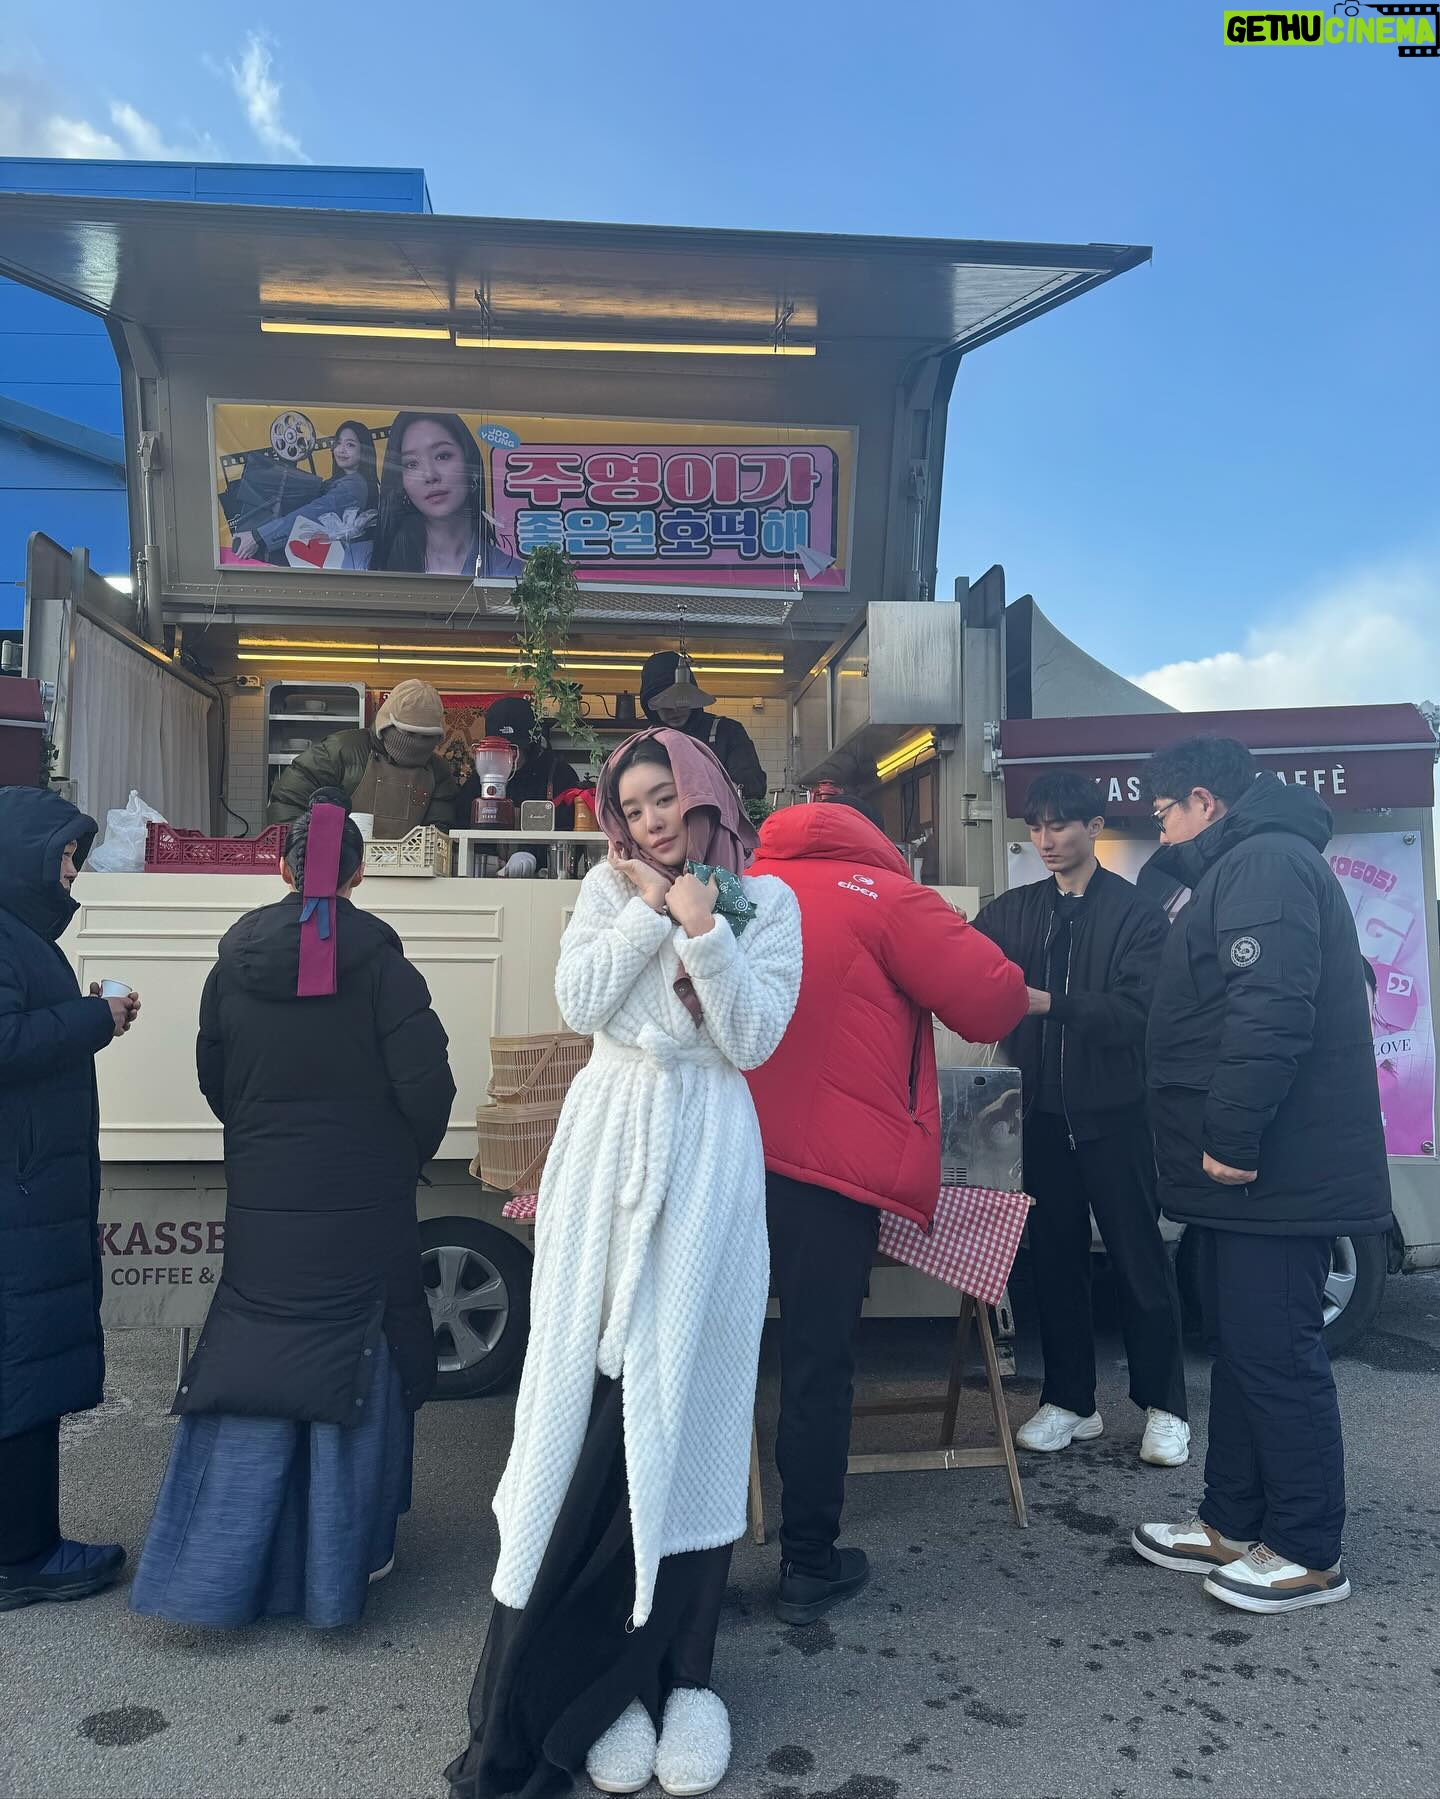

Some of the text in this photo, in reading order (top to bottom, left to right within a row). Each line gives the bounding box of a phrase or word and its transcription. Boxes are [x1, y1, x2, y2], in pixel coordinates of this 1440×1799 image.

[481, 431, 515, 448] YOUNG
[489, 428, 510, 439] JOO
[504, 452, 822, 506] 주영이가
[1095, 776, 1140, 802] AS
[1255, 764, 1347, 795] FFÈ
[1376, 1038, 1412, 1056] OVE
[111, 1267, 215, 1286] COFFEE &
